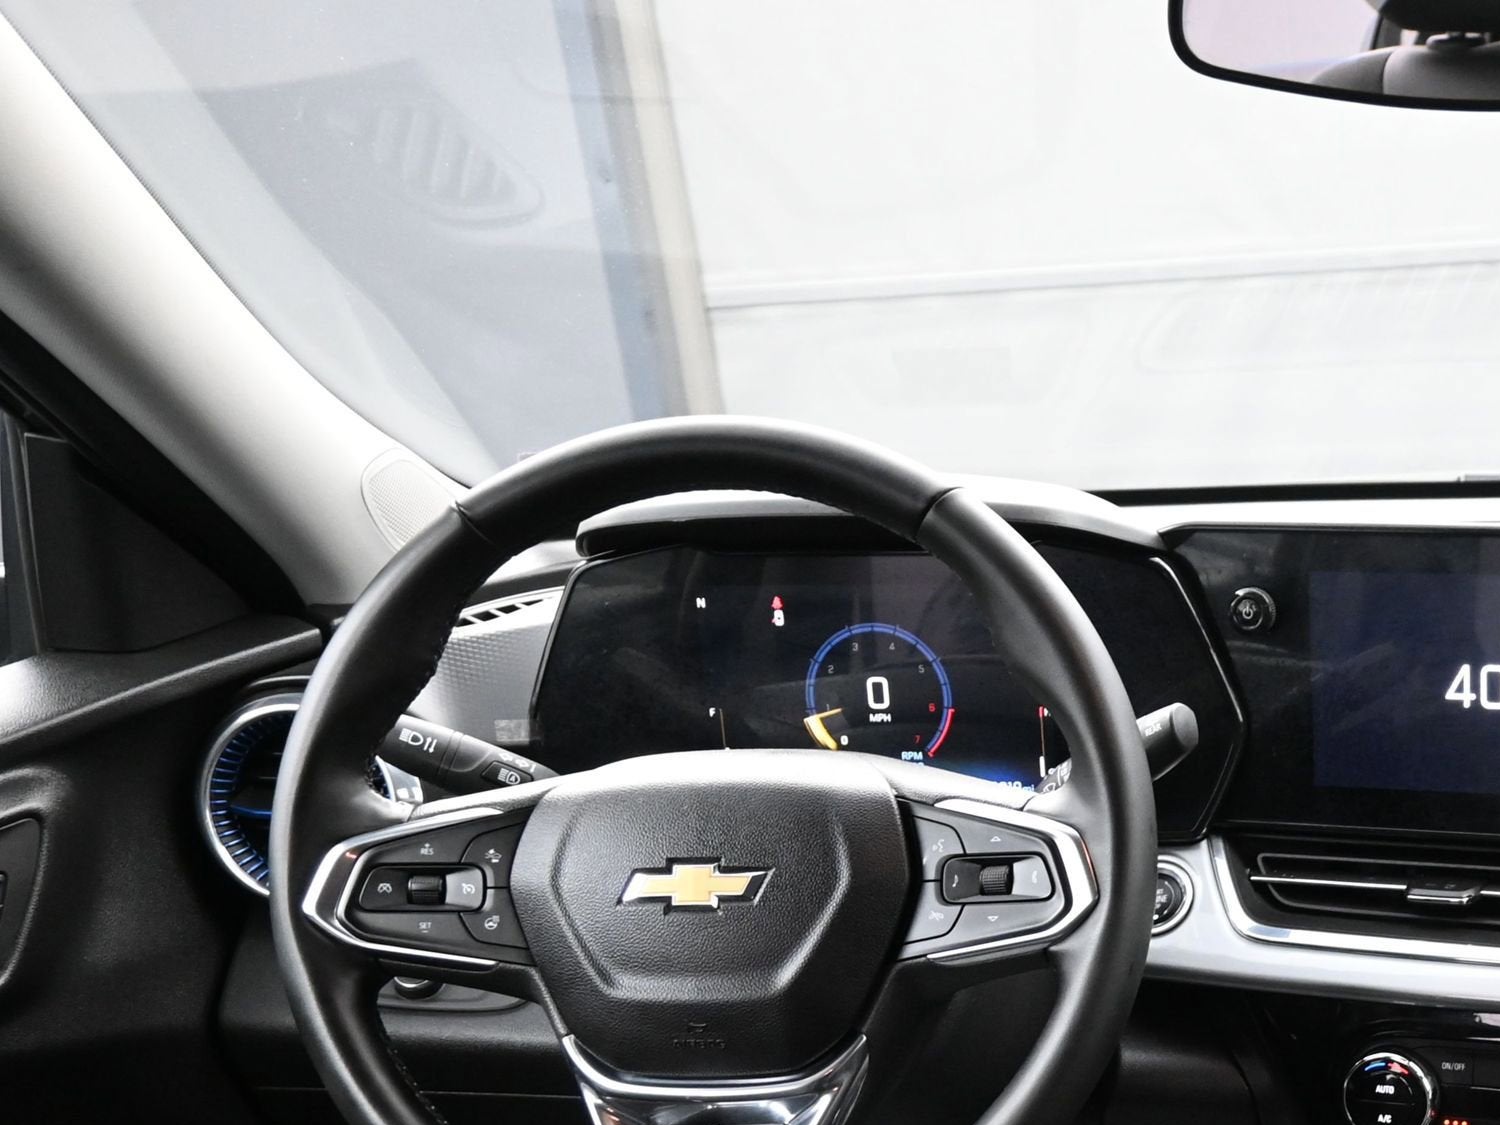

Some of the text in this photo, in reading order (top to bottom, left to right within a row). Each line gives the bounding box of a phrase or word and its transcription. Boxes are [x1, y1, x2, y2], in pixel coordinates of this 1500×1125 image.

[696, 597, 706, 609] N
[852, 642, 859, 652] 3
[888, 642, 896, 651] 4
[827, 664, 835, 674] 2
[917, 664, 925, 674] 5
[866, 676, 890, 709] 0
[869, 713, 891, 723] MPH
[902, 751, 923, 761] RPM
[419, 921, 432, 929] SET
[1441, 1061, 1466, 1071] ON/OFF
[1375, 1084, 1395, 1095] AUTO
[1377, 1114, 1392, 1124] A/C
